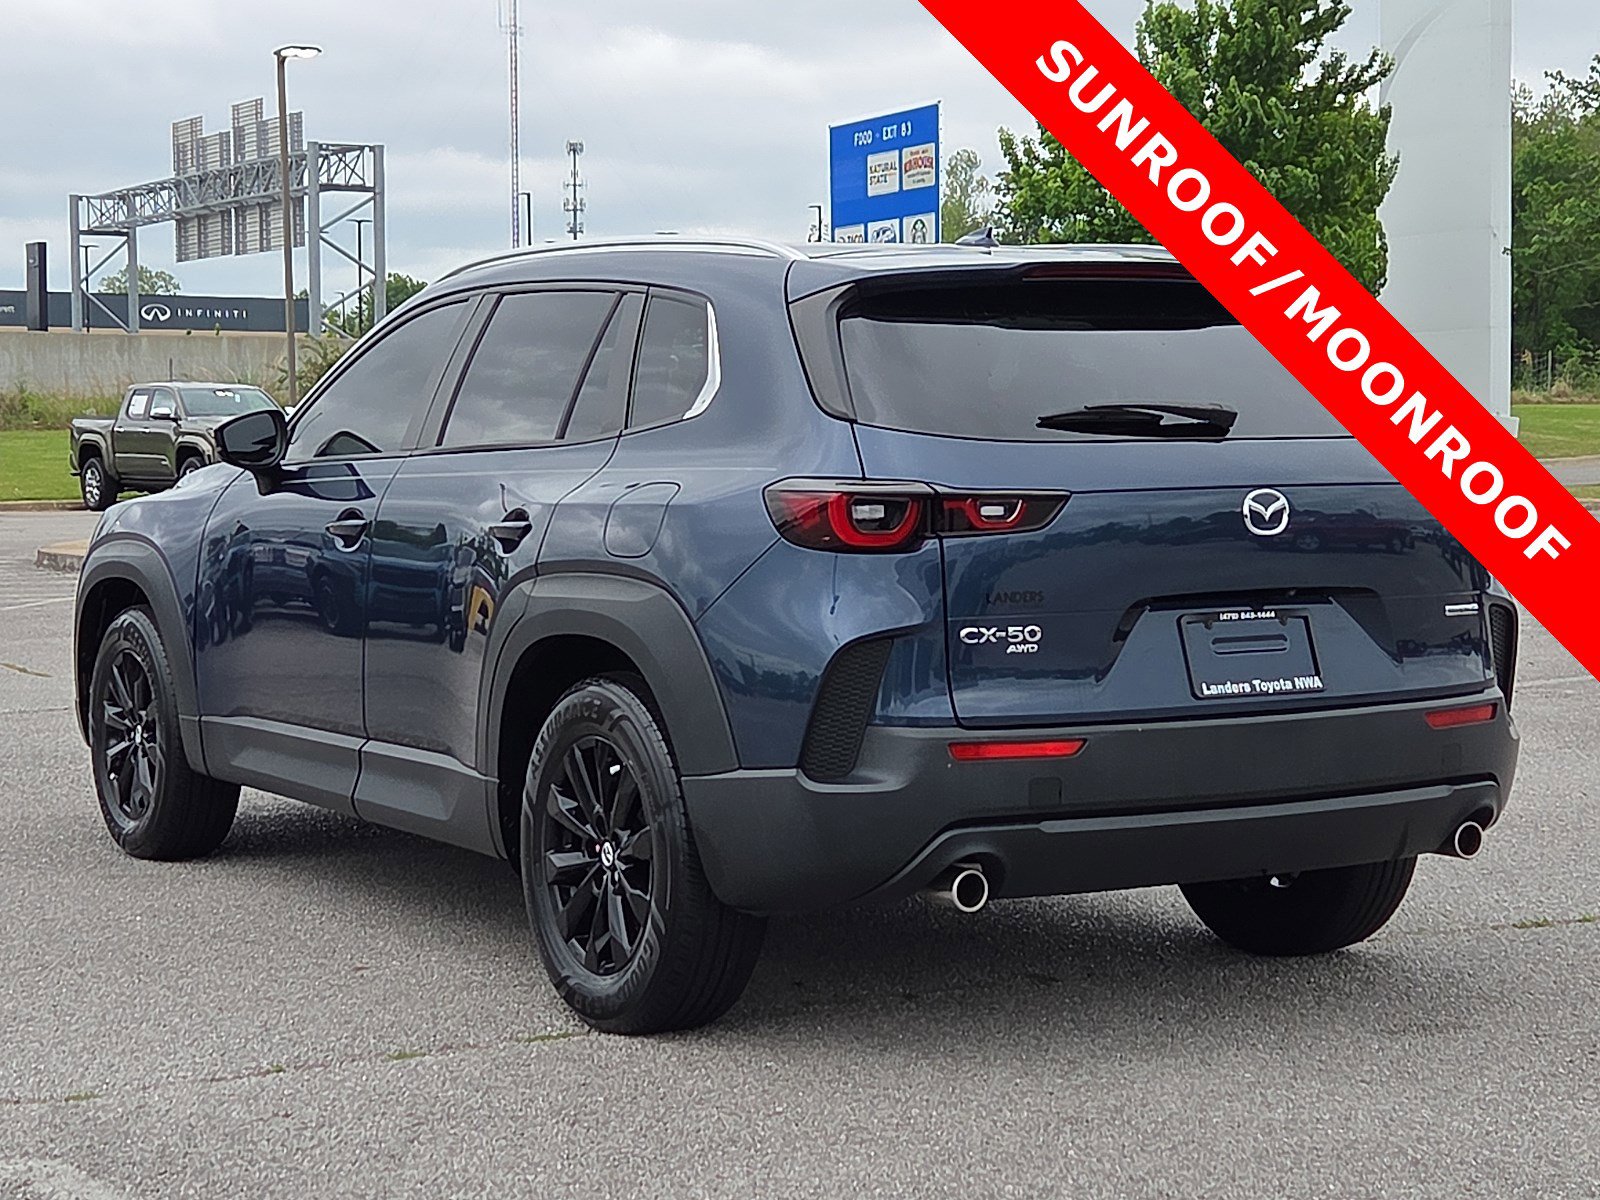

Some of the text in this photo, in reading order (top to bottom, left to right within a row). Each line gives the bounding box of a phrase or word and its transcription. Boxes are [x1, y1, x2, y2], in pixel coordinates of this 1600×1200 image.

[853, 130, 873, 147] FOOD
[882, 124, 898, 141] EXIT
[869, 161, 898, 174] NATURAL
[869, 173, 889, 186] STATE
[177, 308, 248, 319] INFINITI
[985, 590, 1044, 606] LANDERS
[959, 625, 1042, 644] CX-50
[1006, 644, 1039, 654] AWD
[1201, 675, 1324, 695] Landers Toyota NWA
